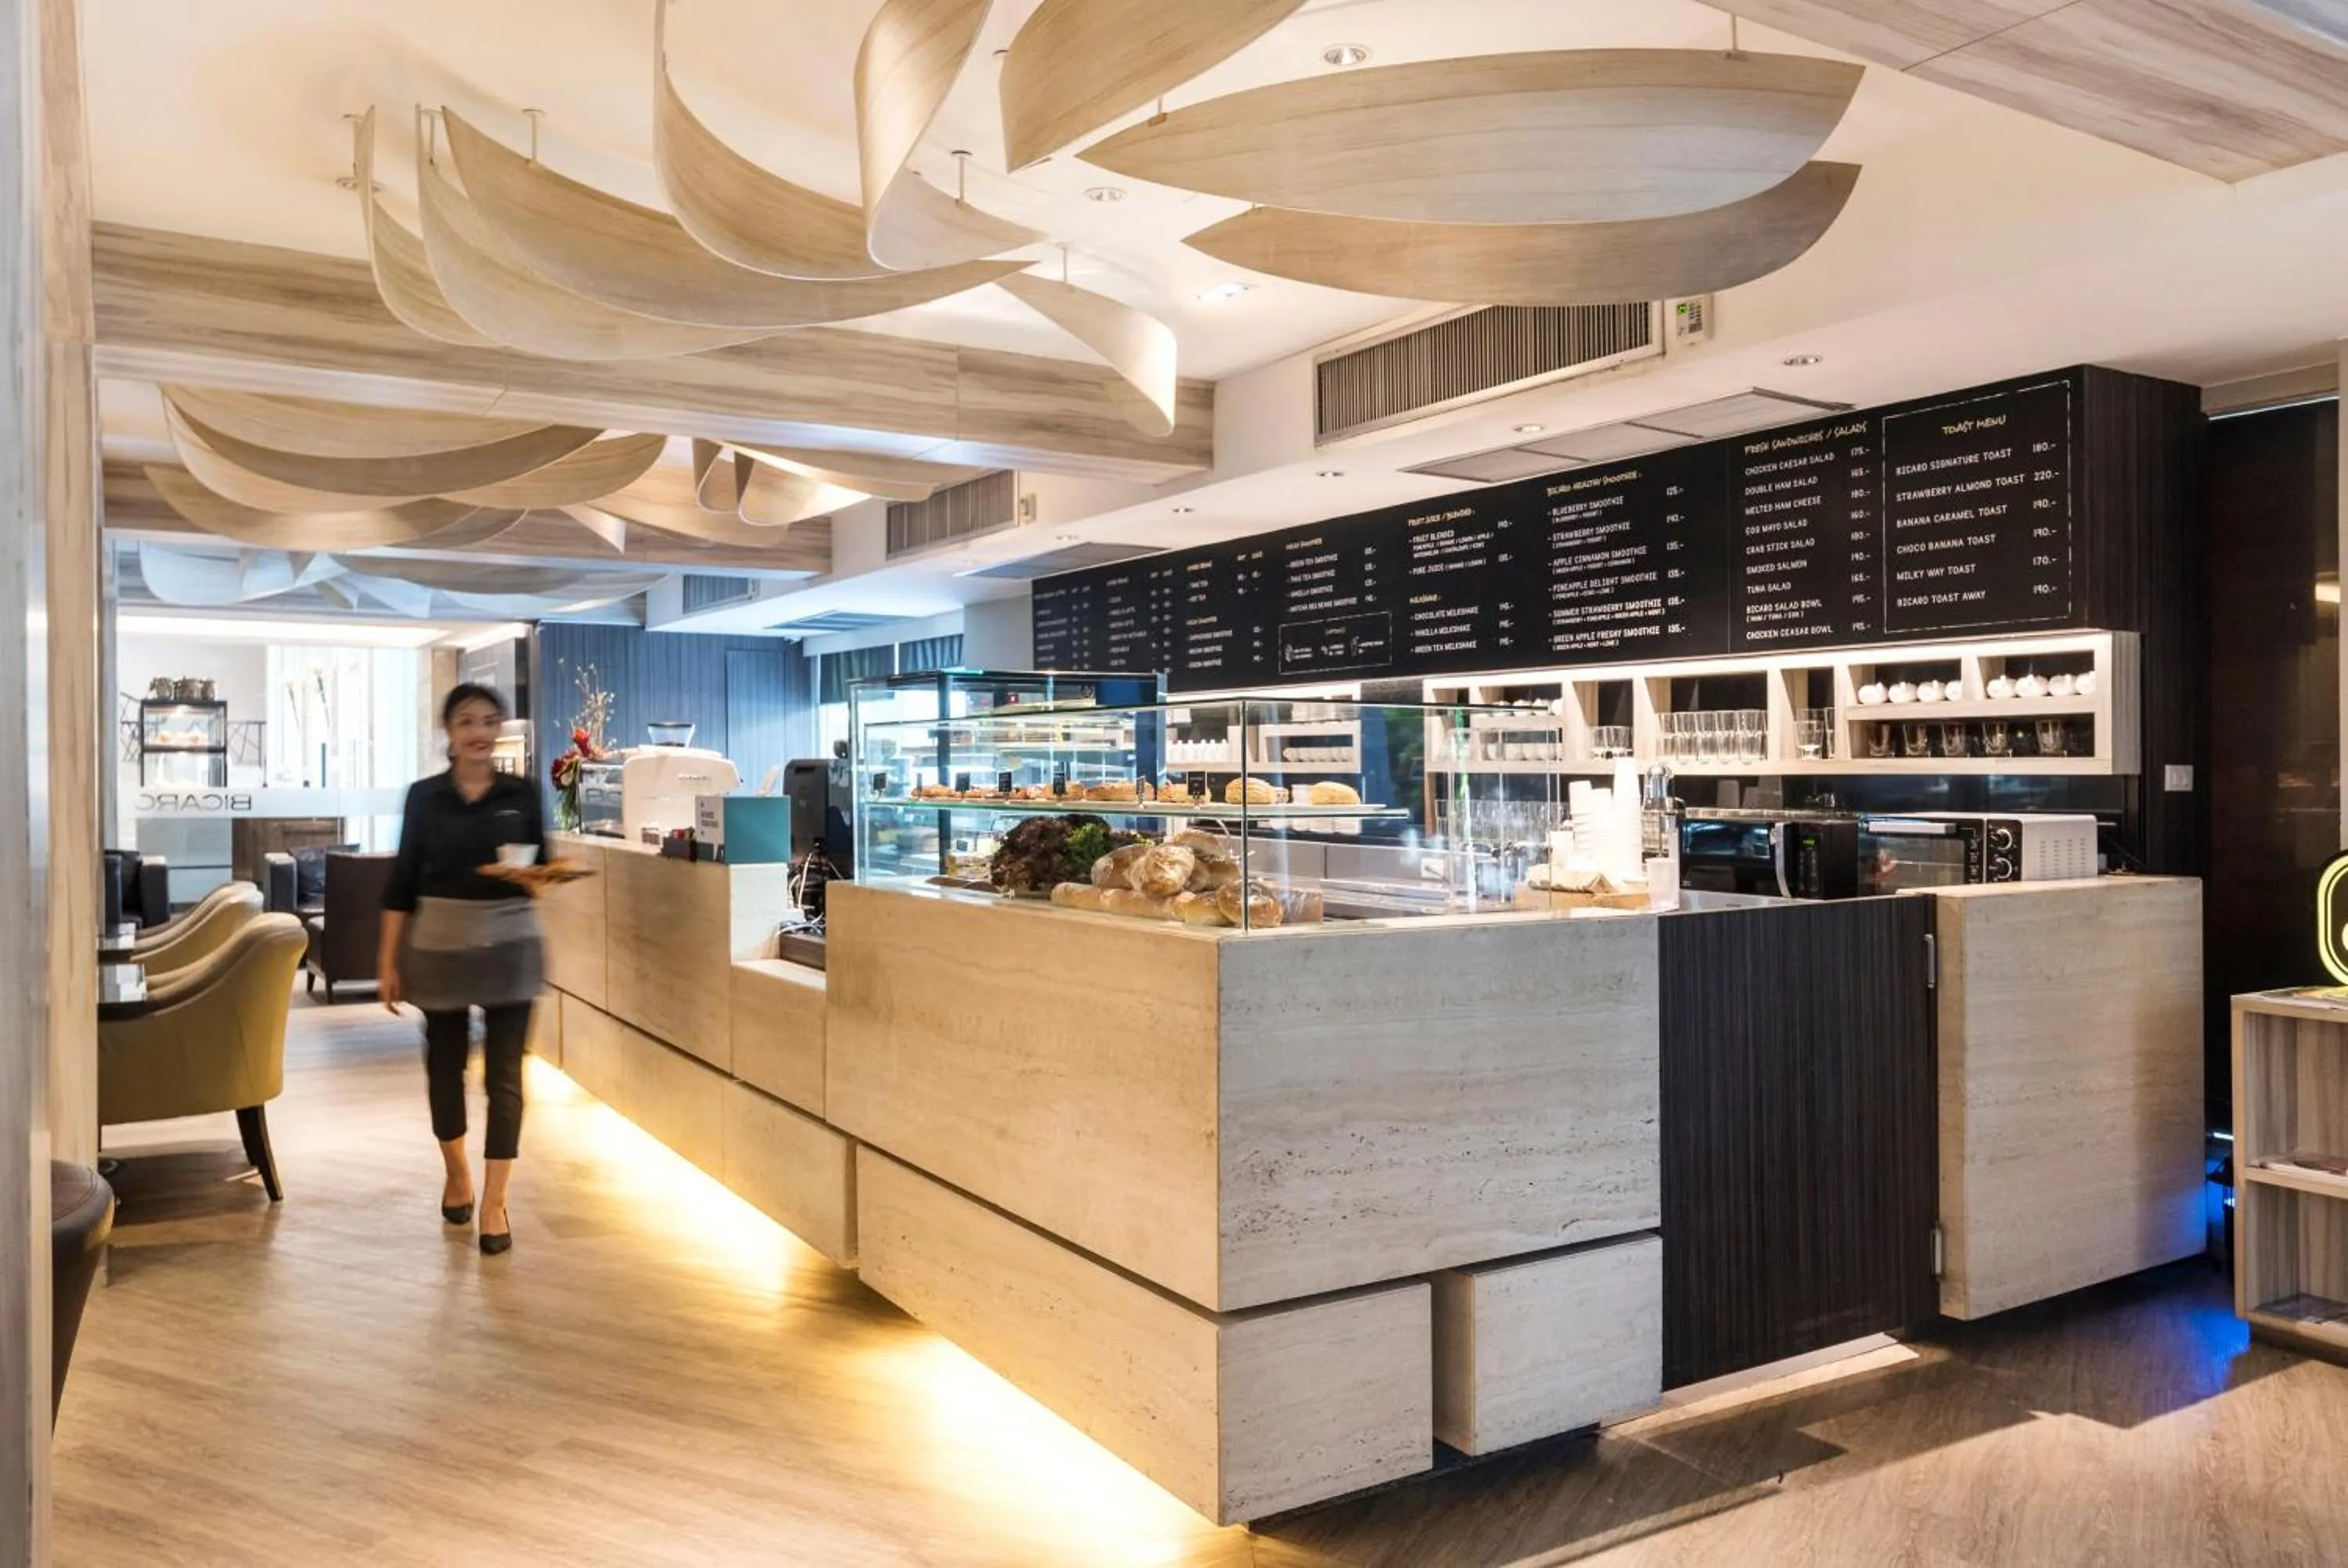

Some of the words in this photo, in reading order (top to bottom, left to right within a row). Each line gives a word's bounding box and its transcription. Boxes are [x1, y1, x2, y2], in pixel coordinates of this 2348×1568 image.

[1834, 421, 1867, 437] SALADS
[1942, 420, 1974, 434] TOAST
[1976, 415, 2006, 429] MENU
[1745, 463, 1777, 476] CHICKEN
[1809, 452, 1835, 464] SALAD
[1929, 453, 1979, 470] SIGNATURE
[1983, 448, 2011, 461] TOAST
[1745, 483, 1773, 495] DOUBLE
[1774, 480, 1792, 491] HAM
[1793, 476, 1818, 487] SALAD
[1896, 486, 1952, 502] STRAWBERRY
[1954, 479, 1993, 493] ALMOND
[1995, 473, 2025, 487] TOAST
[1589, 495, 1624, 509] SMOOTHIE
[1745, 503, 1774, 515] MELTED
[1774, 501, 1792, 510] HAM
[1793, 495, 1821, 508] CHEESE
[1896, 516, 1931, 528] BANANA
[1933, 509, 1975, 523] CARAMEL
[1978, 504, 2008, 516] TOAST
[1595, 521, 1630, 534] SMOOTHIE
[1783, 519, 1807, 530] SALAD
[1766, 541, 1788, 552] STICK
[1790, 538, 1815, 548] SALAD
[1896, 542, 1926, 555] CHOCO
[1928, 538, 1964, 551] BANANA
[1967, 534, 1996, 545] TOAST
[1553, 556, 1572, 566] APPLE
[1611, 545, 1647, 559] SMOOTHIE
[1746, 563, 1775, 574] SMOKED
[1777, 559, 1807, 570] SALMON
[1896, 570, 1925, 581] MILKY
[1926, 568, 1945, 577] WAY
[1947, 563, 1976, 575] TOAST
[2033, 556, 2057, 566] 170.-
[1620, 571, 1657, 584] SMOOTHIE
[1747, 584, 1766, 594] TUNA
[1767, 581, 1792, 592] SALAD
[1625, 599, 1662, 610] SMOOTHIE
[1931, 592, 1959, 603] TOAST
[1962, 590, 1986, 601] AWAY
[1774, 601, 1799, 611] SALAD
[1800, 599, 1822, 609] BOWL
[1575, 631, 1595, 641] APPLE
[1623, 625, 1660, 637] SMOOTHIE
[1746, 630, 1778, 640] CHICKEN
[1810, 625, 1833, 635] BOWL
